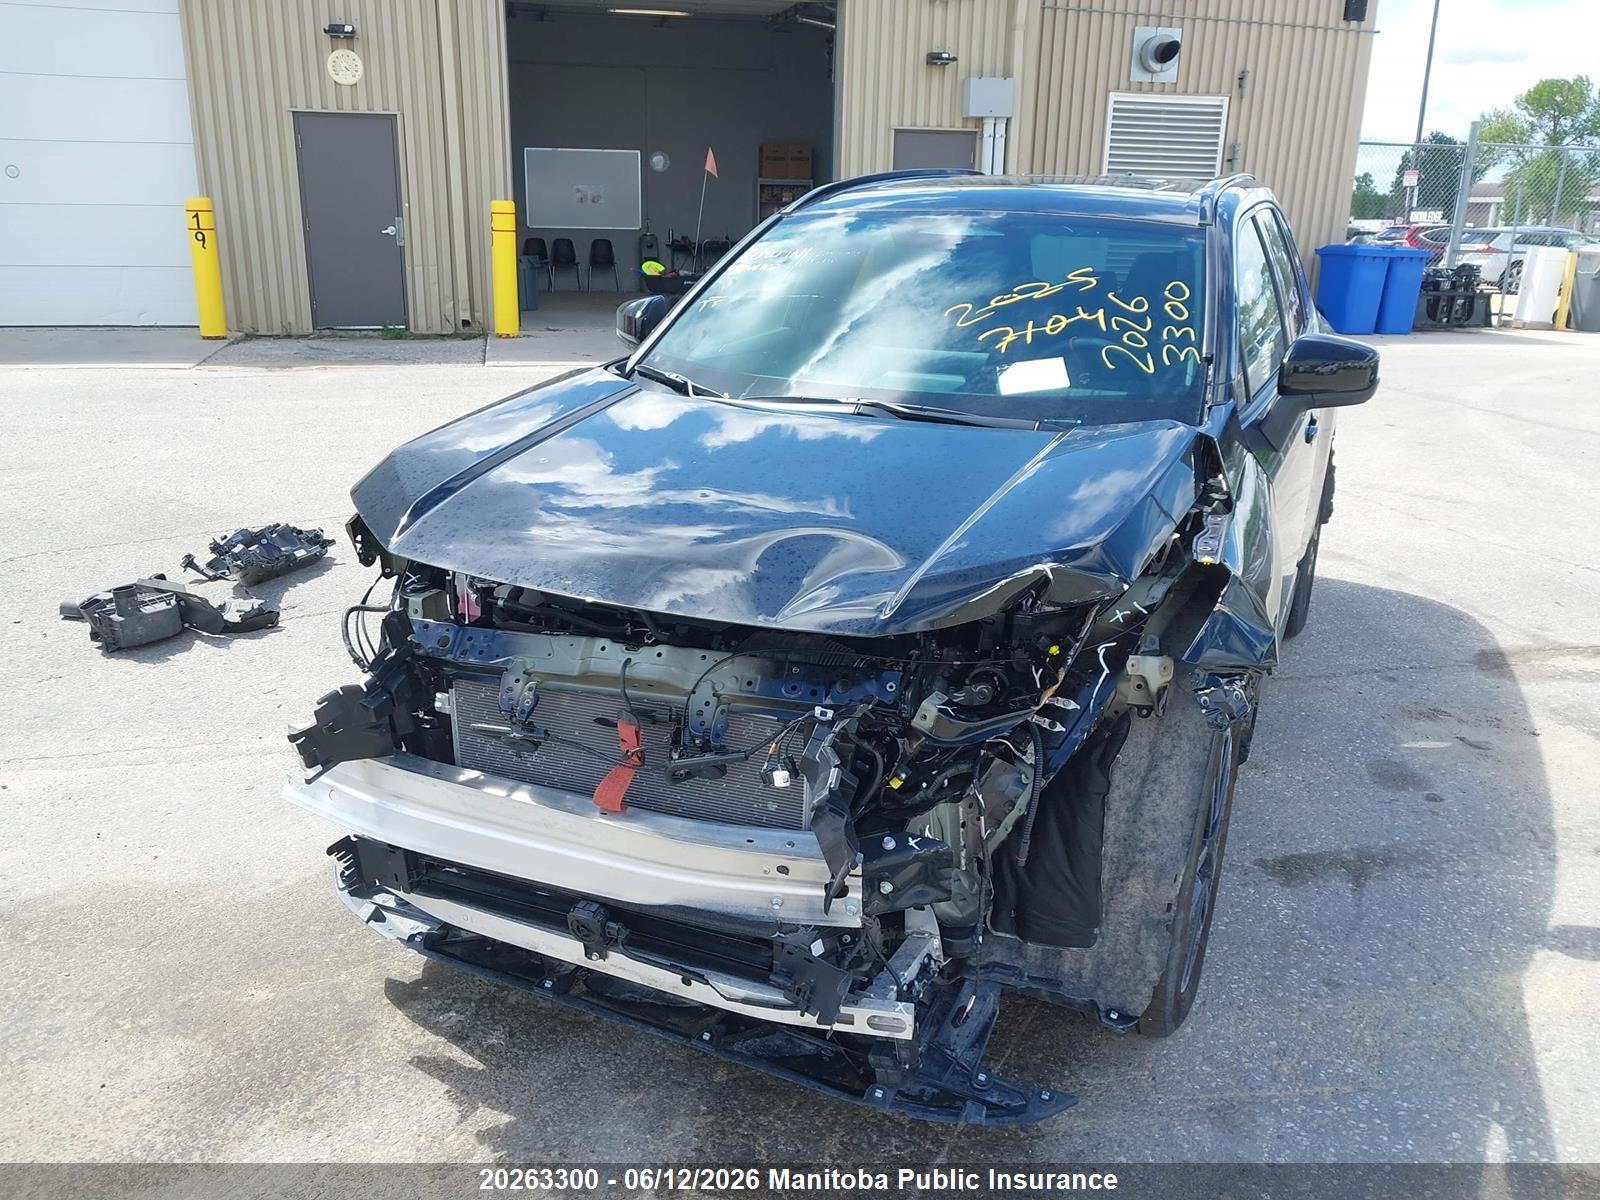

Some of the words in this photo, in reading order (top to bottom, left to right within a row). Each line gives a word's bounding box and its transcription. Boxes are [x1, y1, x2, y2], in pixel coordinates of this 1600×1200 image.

[944, 267, 1098, 327] 2025
[1101, 291, 1155, 374] 2026
[1162, 280, 1202, 366] 3300
